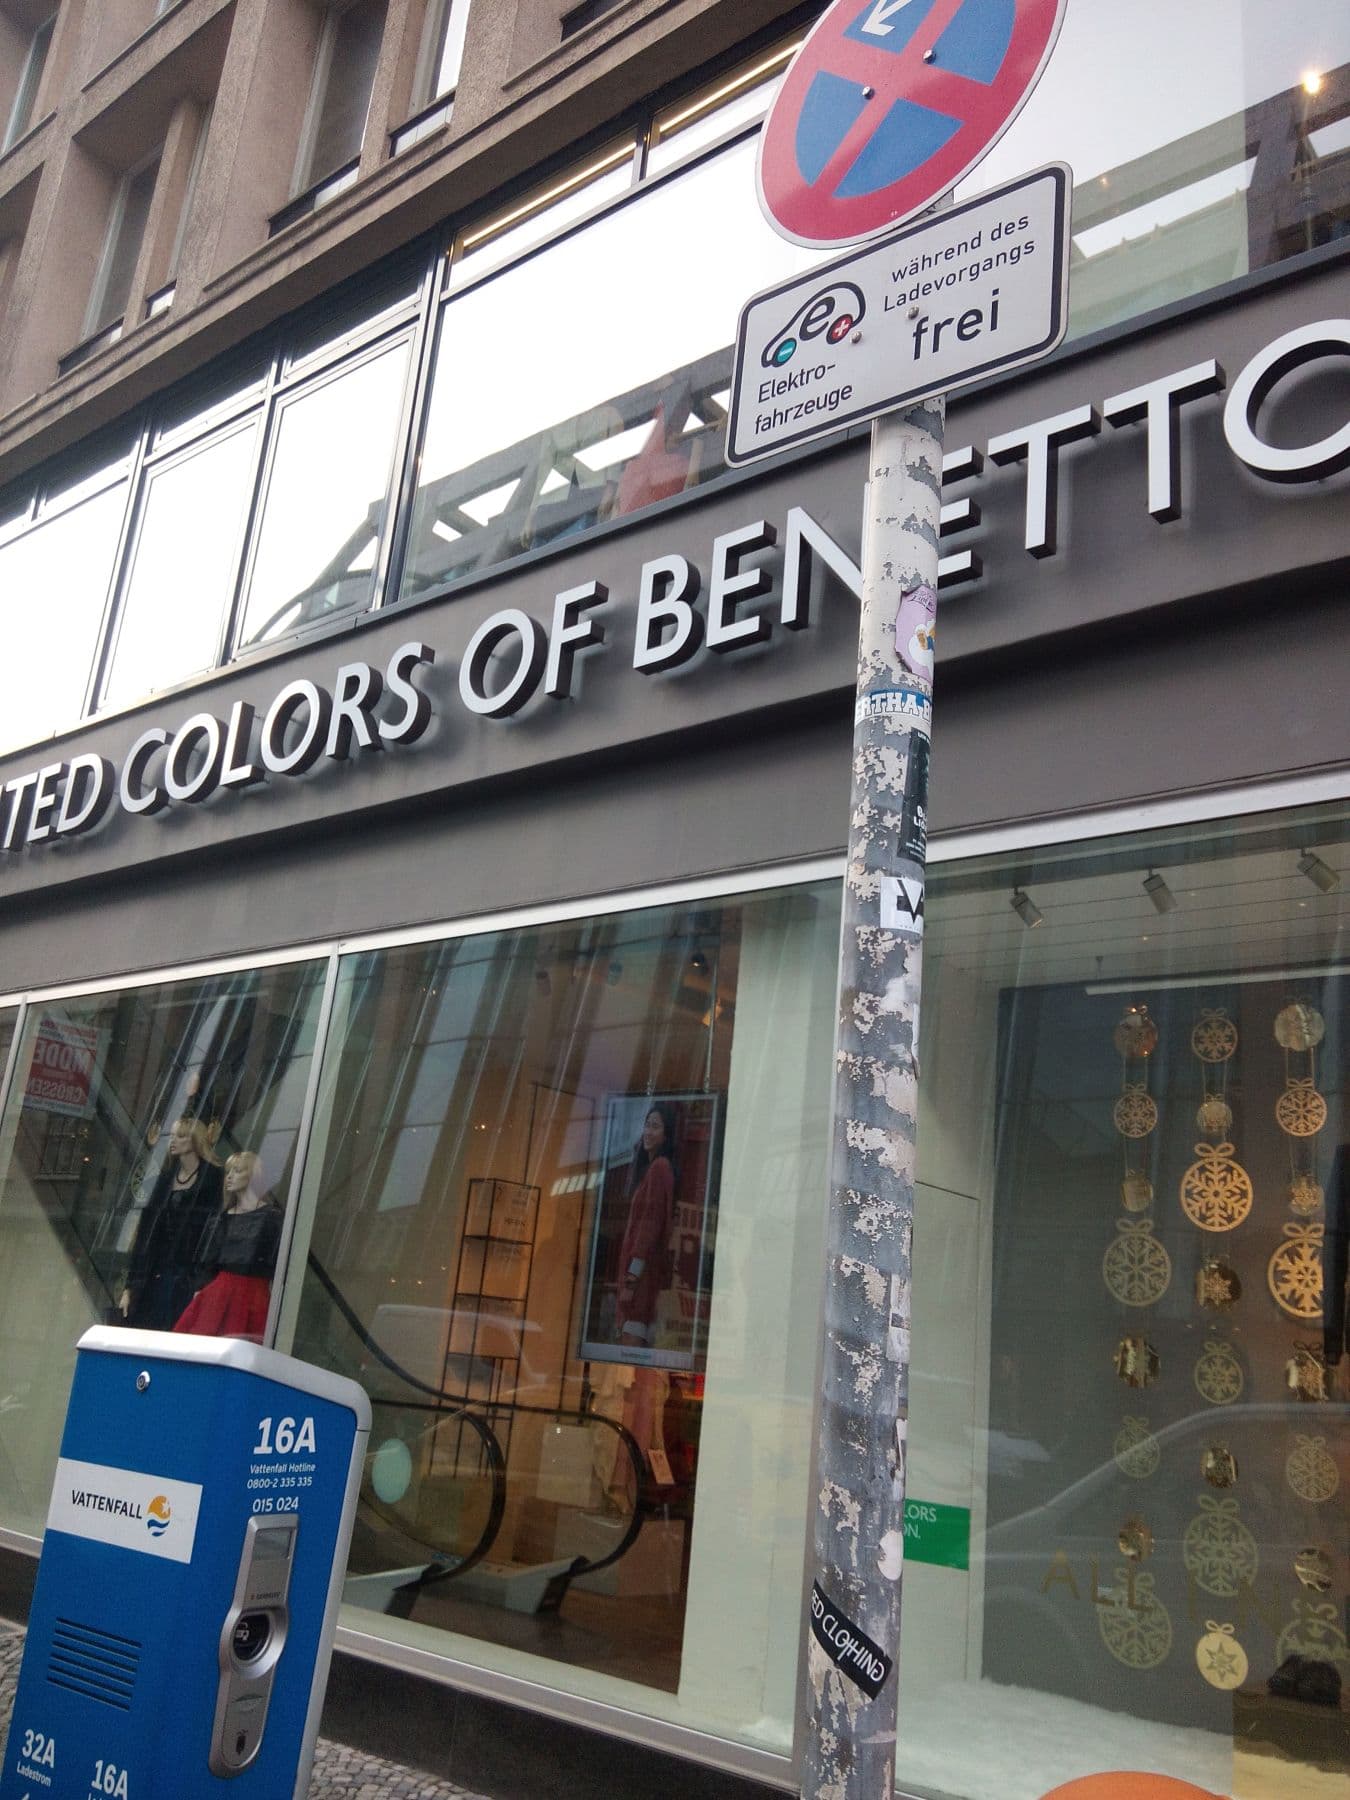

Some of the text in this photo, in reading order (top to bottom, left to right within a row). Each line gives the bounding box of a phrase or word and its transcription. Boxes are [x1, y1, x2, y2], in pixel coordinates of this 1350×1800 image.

[892, 215, 1030, 283] während des
[884, 240, 1035, 312] Ladevorgangs
[912, 289, 1000, 360] frei
[758, 363, 836, 403] Elektro-
[755, 385, 852, 434] fahrzeuge
[0, 752, 115, 852] TED
[120, 641, 436, 816] COLORS
[458, 580, 610, 720] OF
[253, 1417, 316, 1454] 16A
[250, 1461, 316, 1474] Vattenfall Hotline
[71, 1489, 143, 1520] VATTENFALL
[252, 1496, 299, 1513] 015 024
[821, 1614, 885, 1682] CLOTHING
[21, 1728, 56, 1769] 32A
[16, 1761, 52, 1788] Ladestrom
[90, 1759, 129, 1800] 16A
